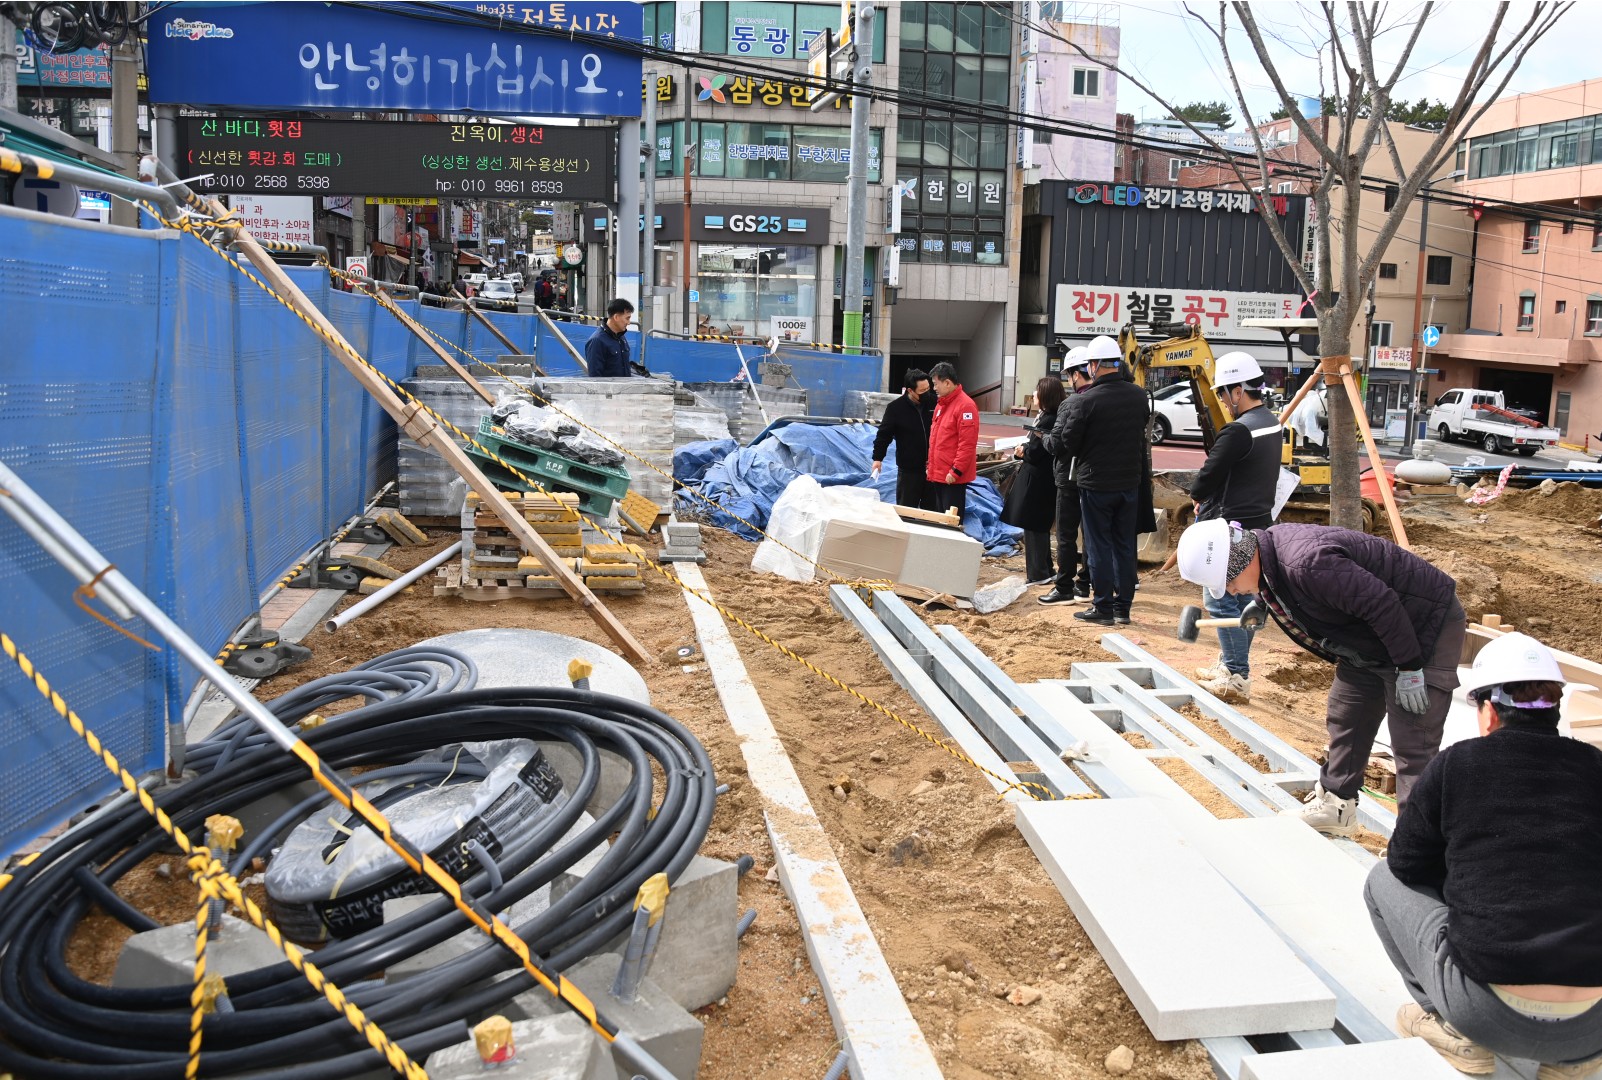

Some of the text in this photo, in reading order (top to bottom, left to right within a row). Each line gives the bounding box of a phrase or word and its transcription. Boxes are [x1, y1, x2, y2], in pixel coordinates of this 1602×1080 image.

[41, 55, 111, 68] 이비인후과
[41, 69, 111, 83] 가정의학과
[728, 143, 789, 160] 한방물리치료
[798, 146, 851, 163] 부항치료
[254, 175, 288, 188] 2568
[297, 175, 330, 189] 5398
[461, 180, 486, 191] 010
[495, 180, 525, 192] 9961
[531, 181, 563, 193] 8593
[1102, 185, 1141, 207] LED
[1144, 187, 1176, 210] 전기
[1180, 190, 1213, 213] 조명
[1216, 192, 1250, 214] 자재
[729, 214, 782, 233] GS25
[1071, 291, 1229, 327] 전기 철물 공구
[777, 321, 807, 330] 1000원
[1165, 349, 1193, 362] YANMAR
[546, 460, 564, 470] KPP
